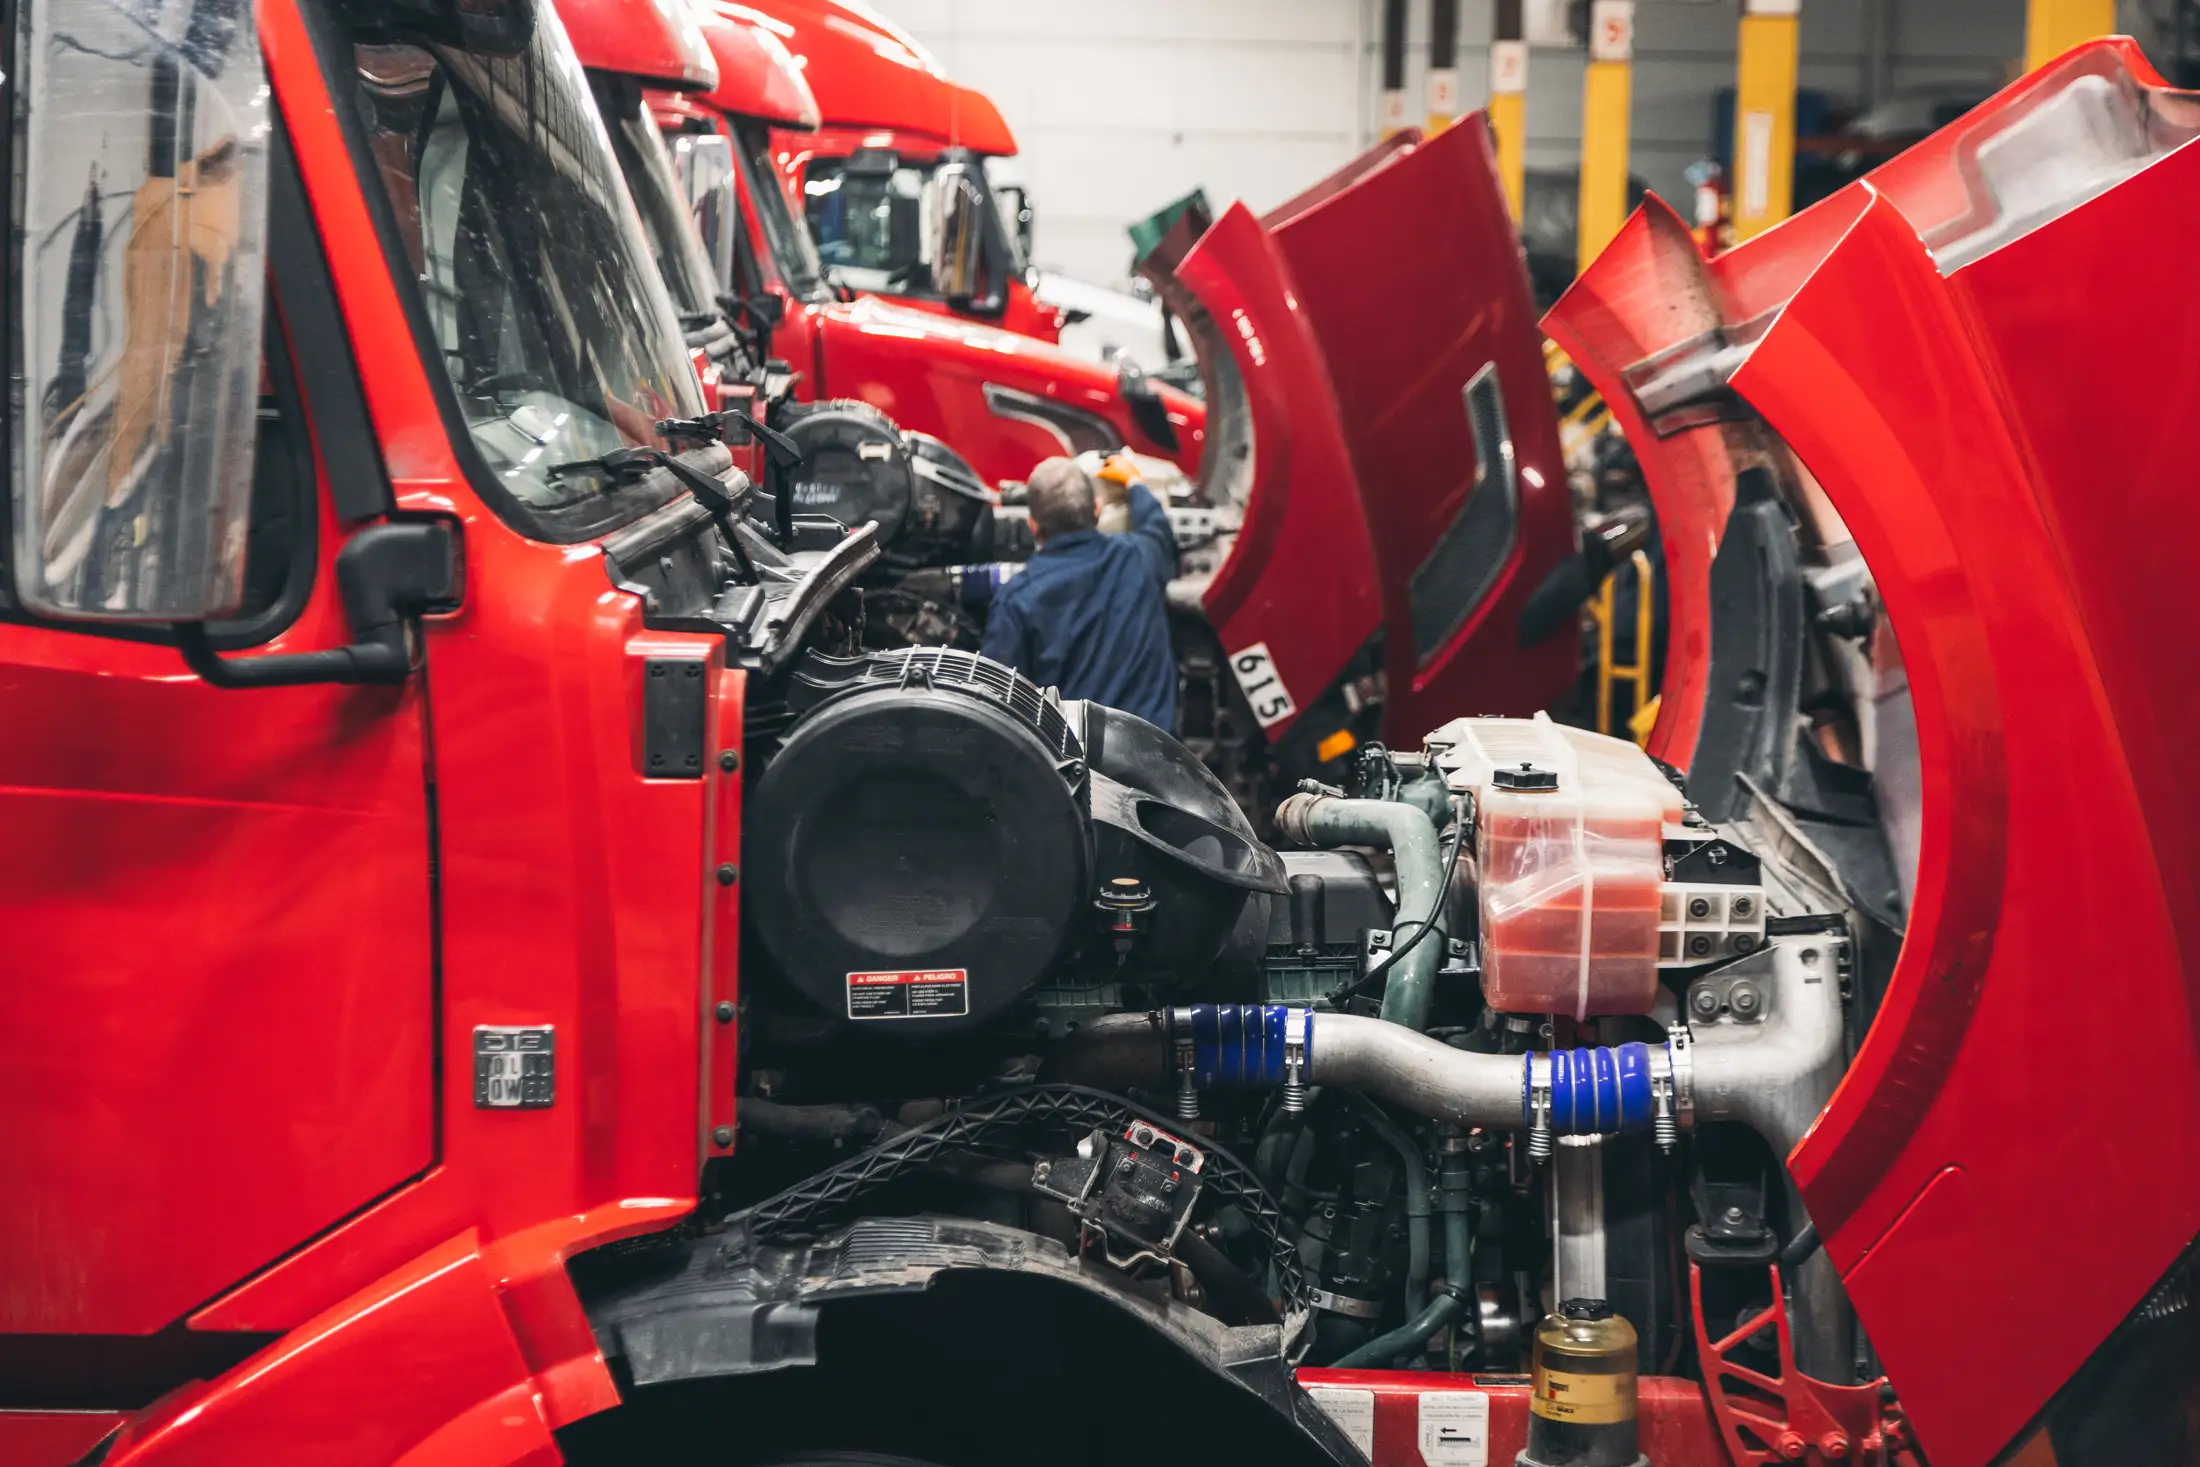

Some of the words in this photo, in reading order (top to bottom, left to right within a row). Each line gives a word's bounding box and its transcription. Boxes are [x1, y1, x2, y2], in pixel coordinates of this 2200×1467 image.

[1239, 655, 1288, 719] 615
[866, 975, 899, 983] DANGER
[922, 973, 956, 981] PELIGRO
[476, 1079, 552, 1103] POWER
